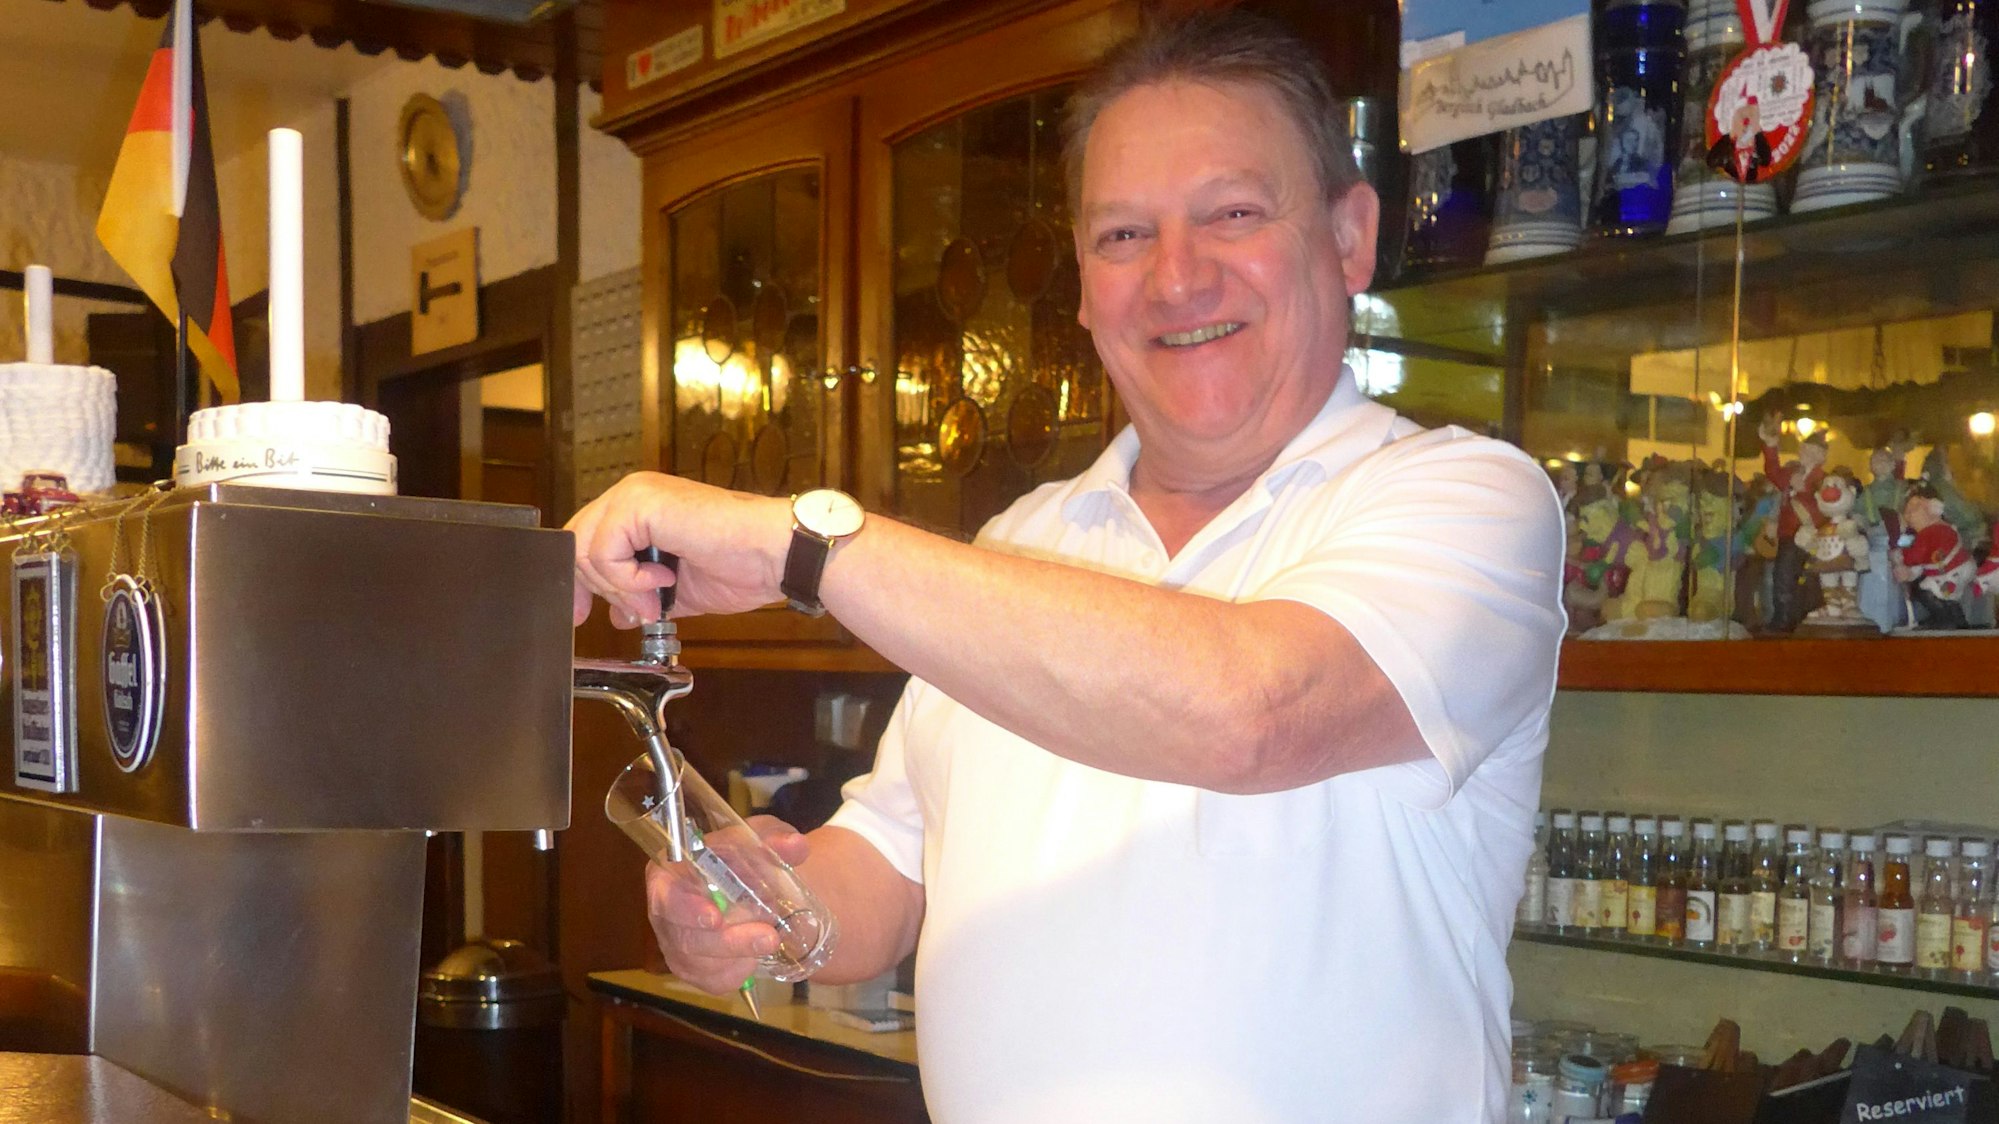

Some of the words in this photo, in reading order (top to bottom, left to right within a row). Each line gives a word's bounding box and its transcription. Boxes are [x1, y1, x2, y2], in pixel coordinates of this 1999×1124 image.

[195, 450, 226, 474] Bitte
[232, 458, 259, 470] ein
[264, 447, 300, 468] Bit
[1856, 1084, 1965, 1122] Reserviert
